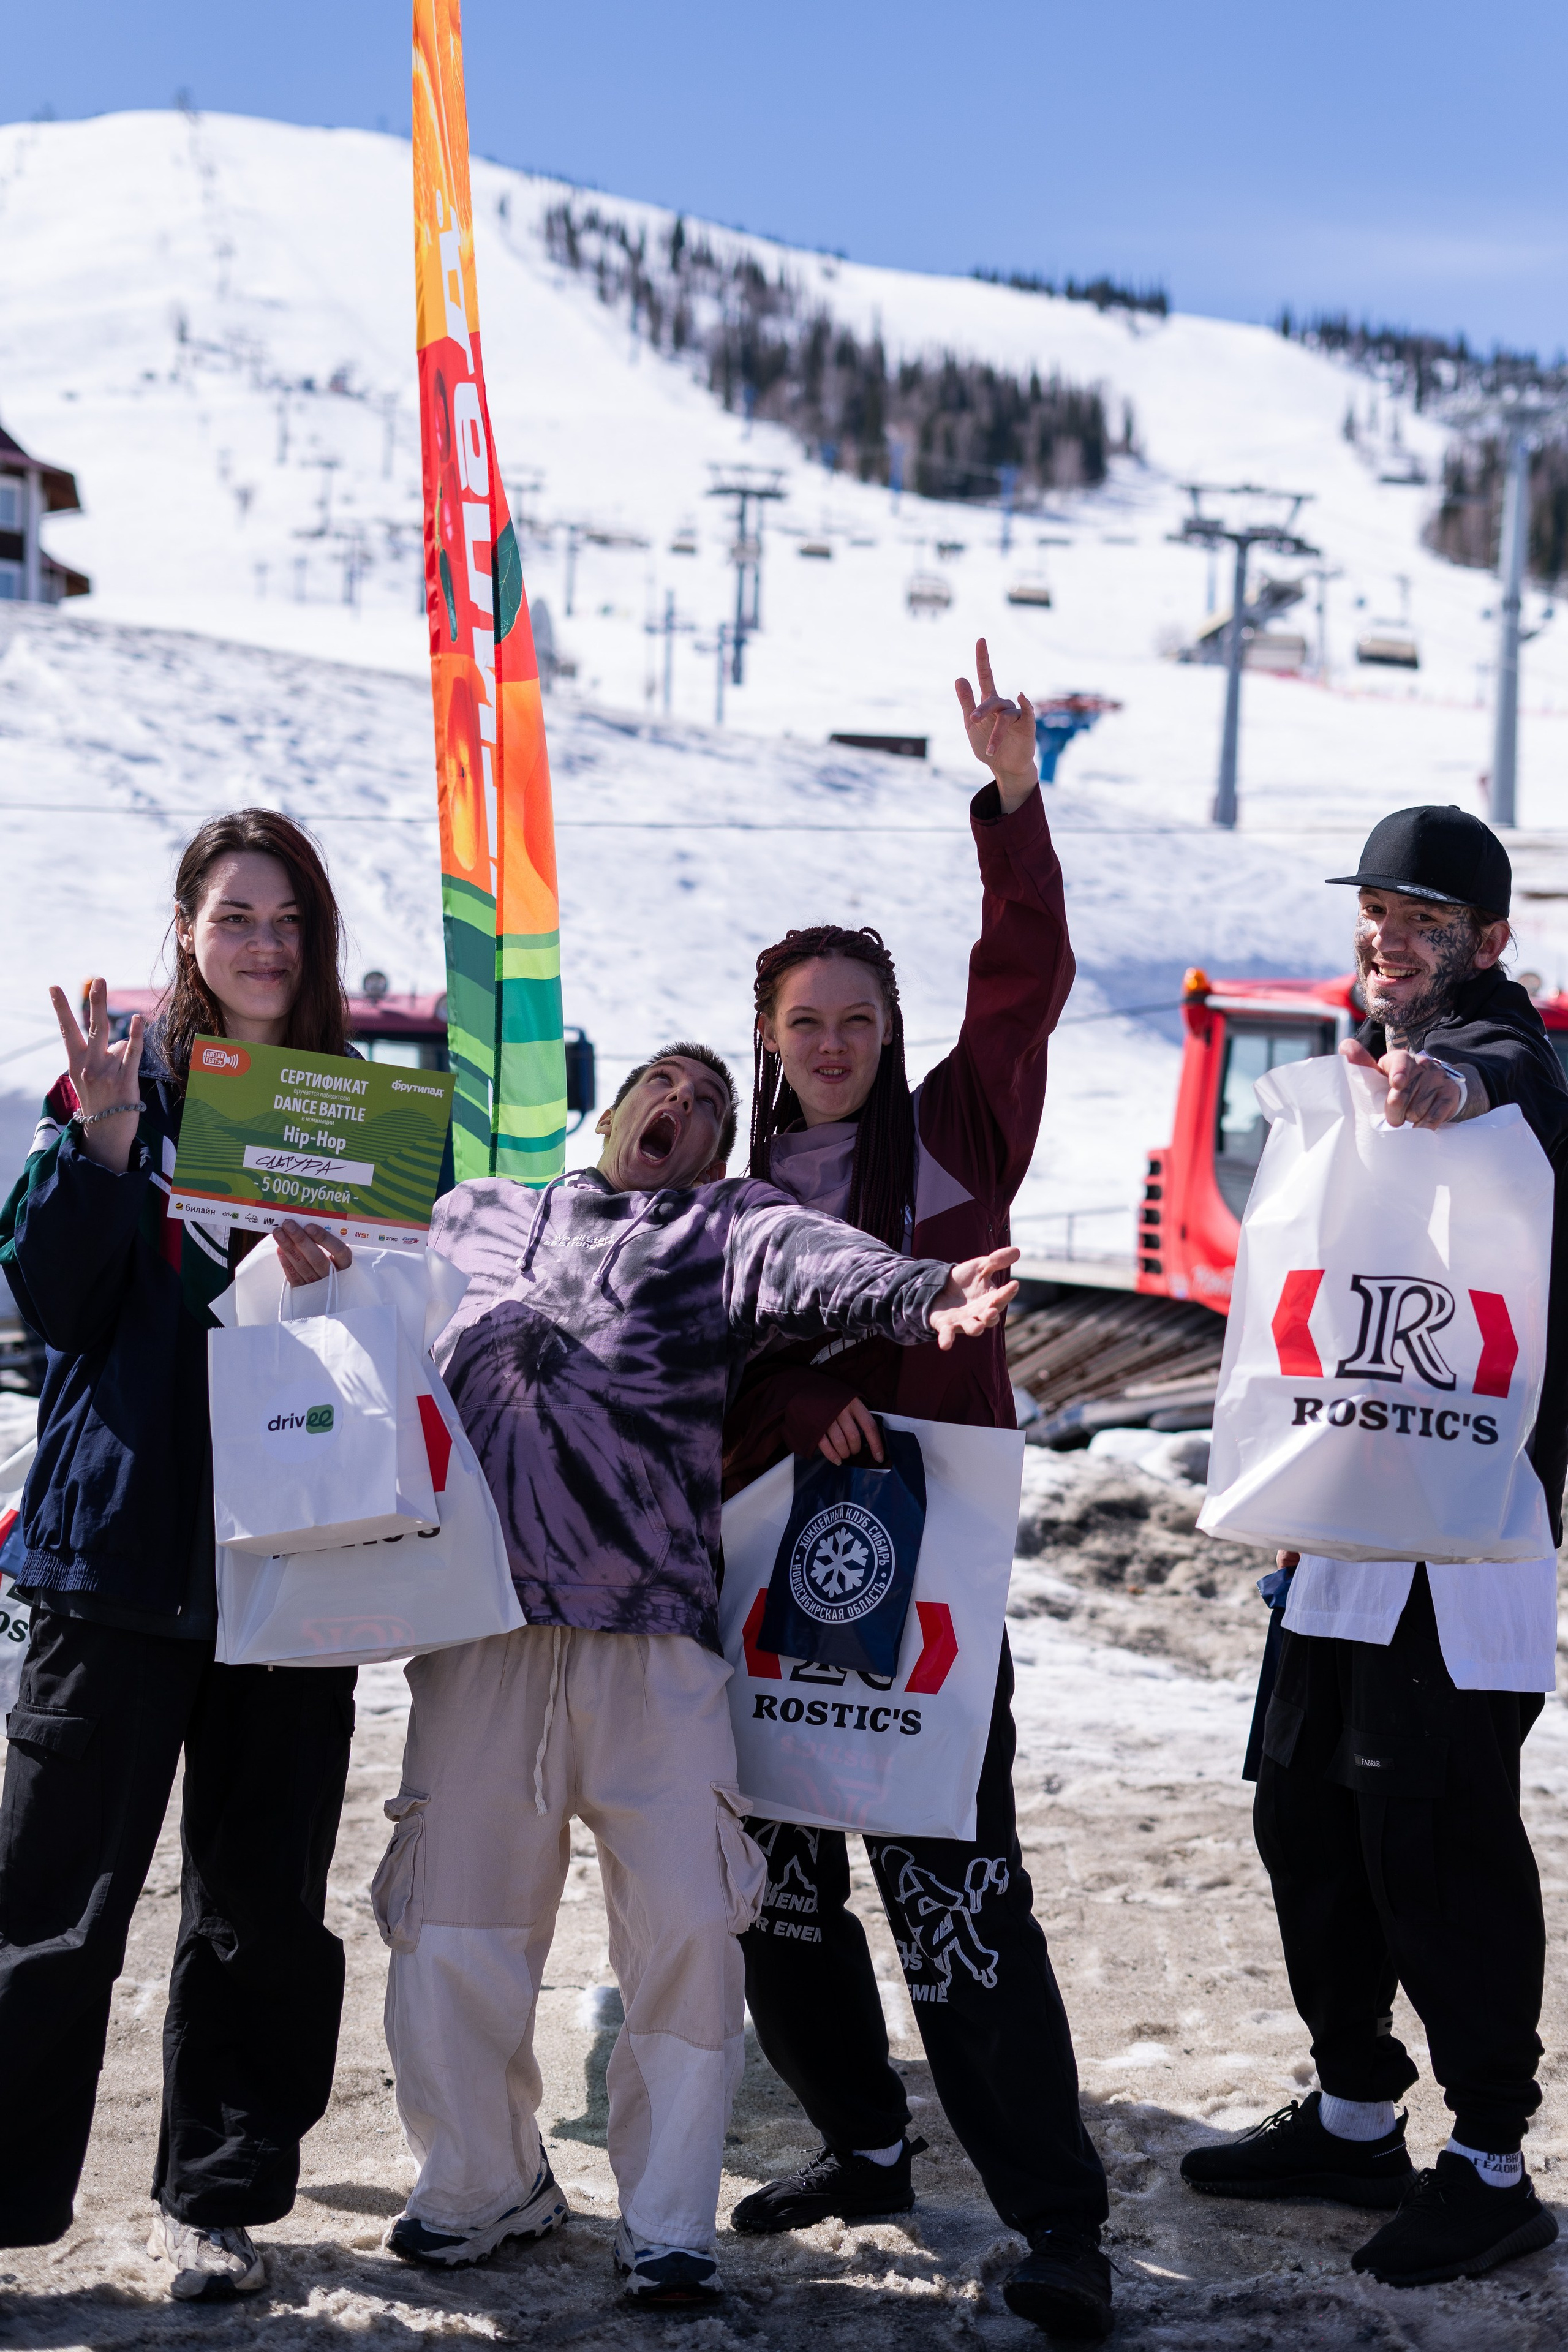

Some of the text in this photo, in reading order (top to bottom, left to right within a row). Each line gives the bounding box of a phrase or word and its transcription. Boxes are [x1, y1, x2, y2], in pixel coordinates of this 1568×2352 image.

[206, 1050, 224, 1060] GRELKA
[281, 1068, 369, 1095] СЕРТИФИКАТ
[274, 1095, 366, 1122] DANCE BATTLE
[320, 1093, 350, 1101] победителю
[306, 1117, 334, 1125] номинации
[284, 1125, 346, 1155] Hip-Hop
[262, 1177, 350, 1204] 5 000 рублей
[185, 1204, 216, 1216] билайн
[559, 1239, 616, 1250] strangers
[586, 1233, 616, 1244] start
[268, 1409, 334, 1432] drivee
[1291, 1397, 1498, 1445] ROSTIC'S
[799, 1506, 890, 1566] ХОККЕЙНЫЙ КЛУБ СИБИРЬ
[792, 1564, 886, 1620] НОВОСИБИРСКАЯ ОБЛАСТЬ
[752, 1694, 922, 1735] ROSTIC'S
